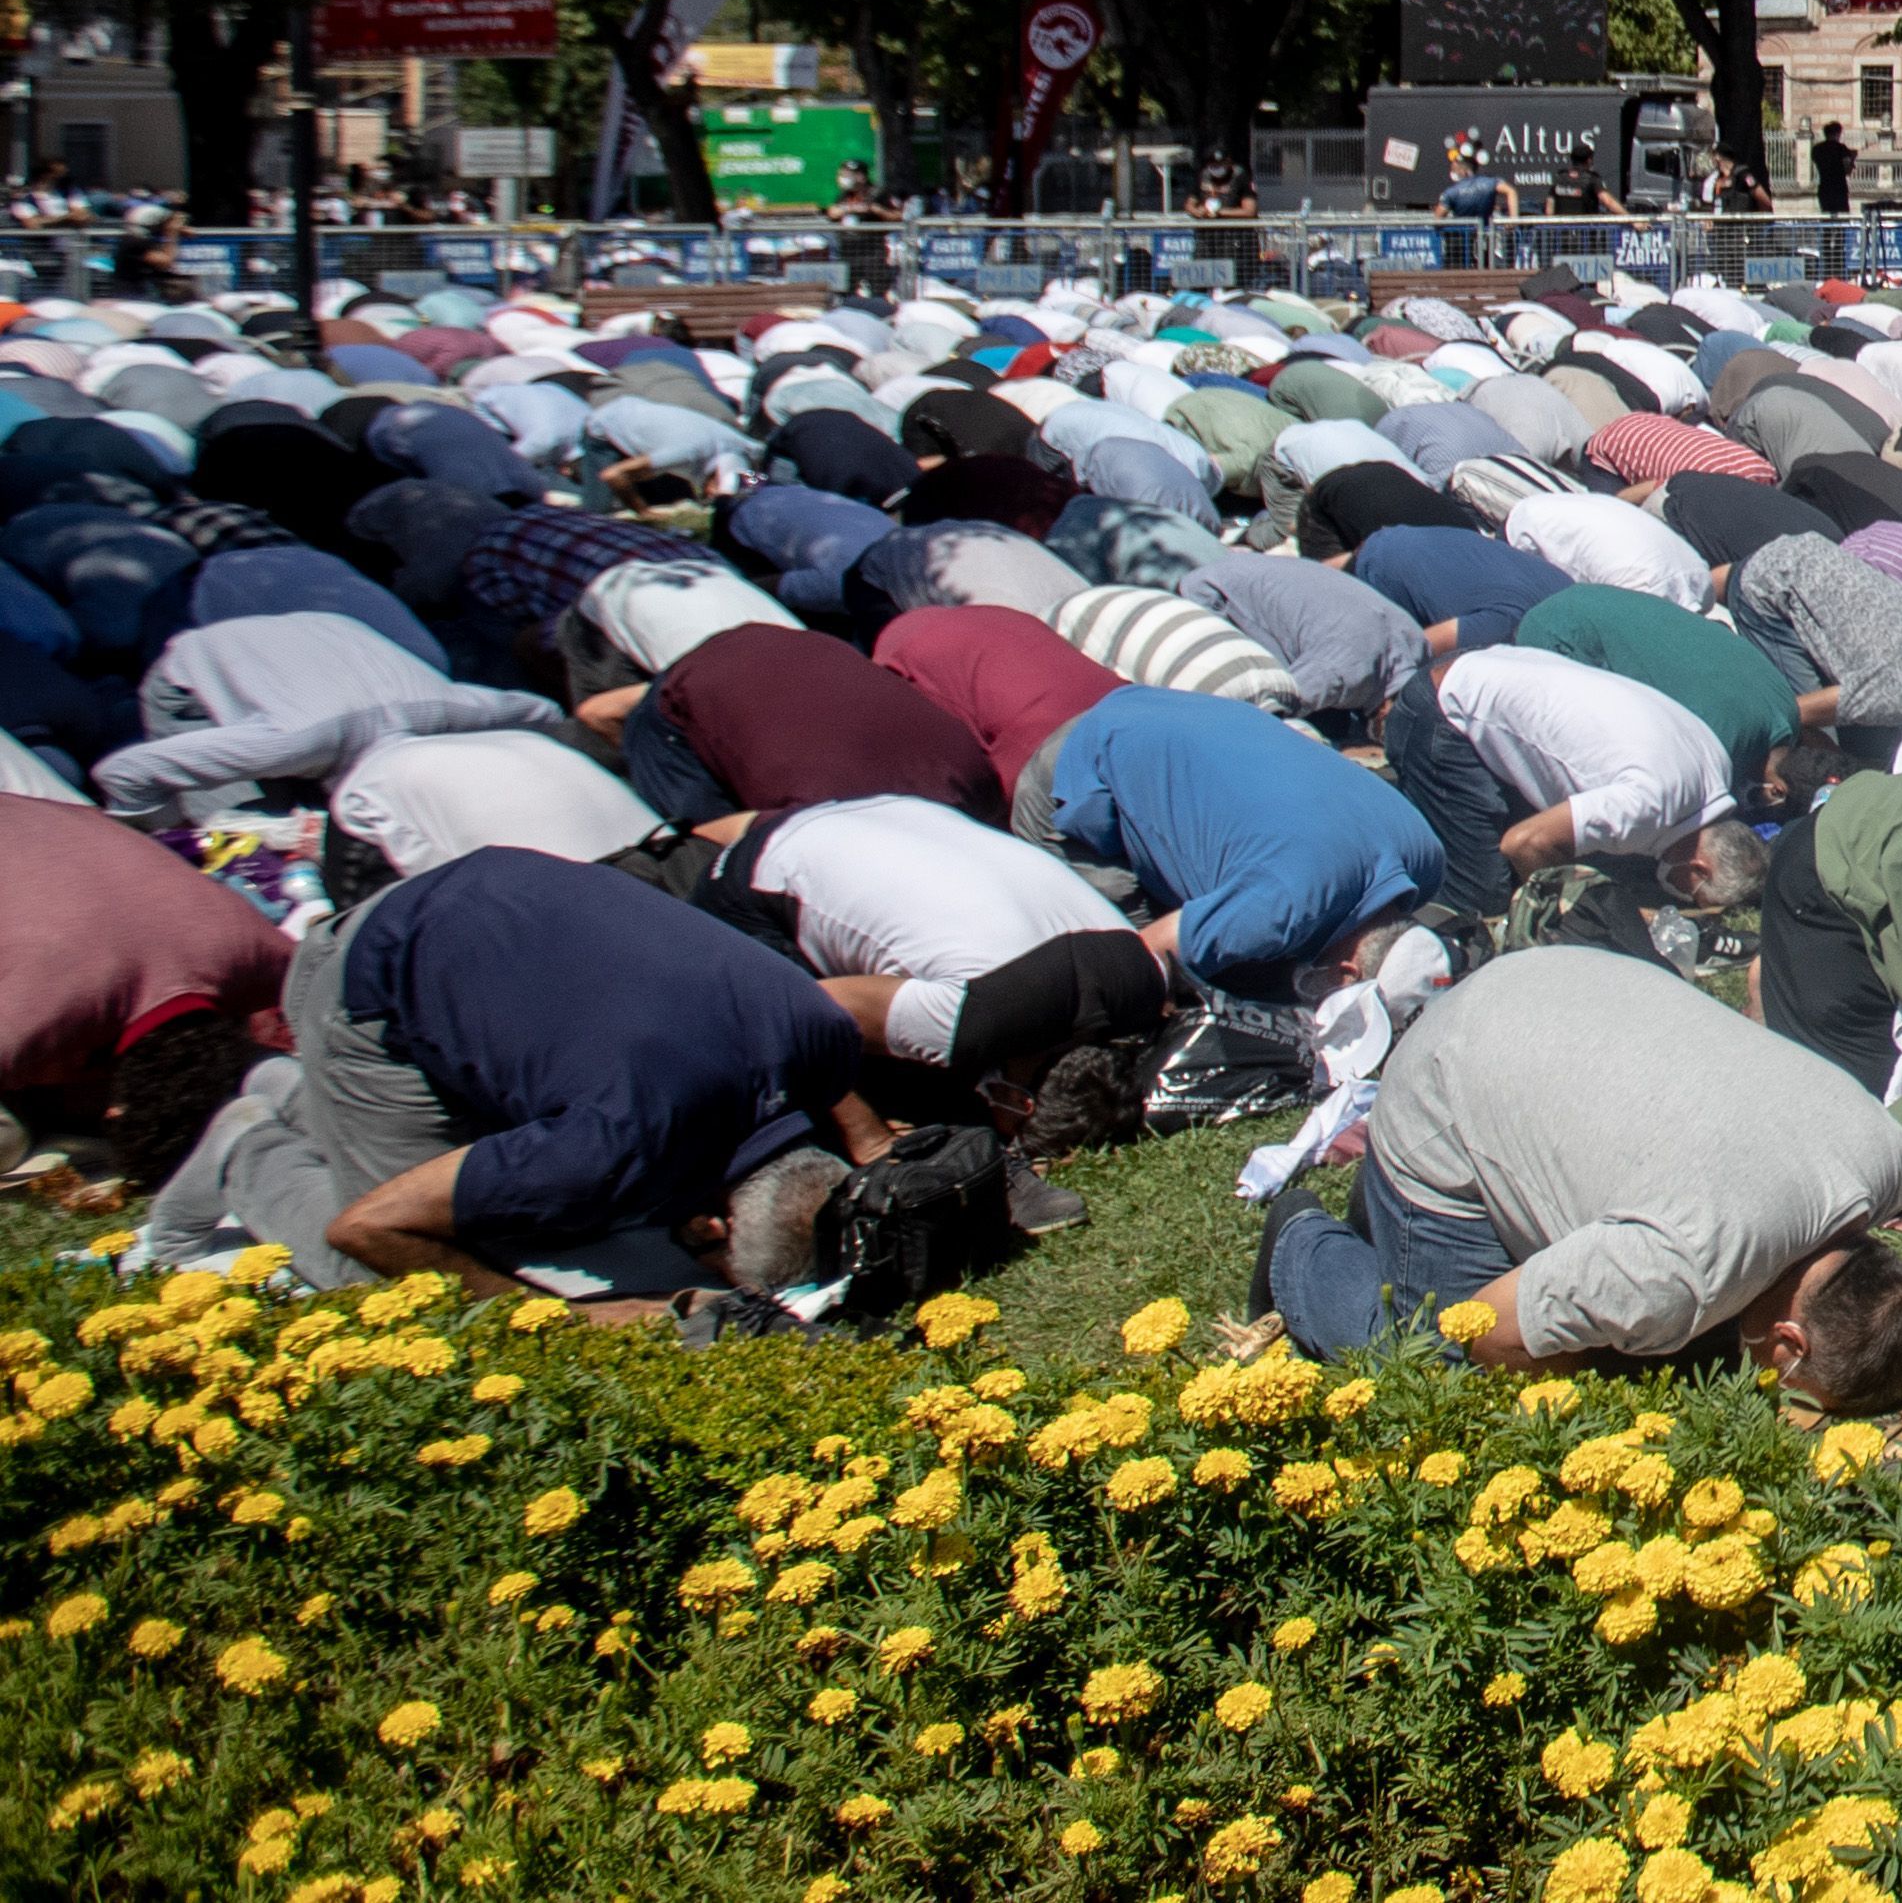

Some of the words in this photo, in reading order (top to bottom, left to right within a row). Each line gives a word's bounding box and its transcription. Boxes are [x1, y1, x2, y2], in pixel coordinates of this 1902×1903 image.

[1495, 123, 1595, 154] Altus
[1616, 249, 1670, 266] ZABITA
[1749, 258, 1801, 280] POLİS
